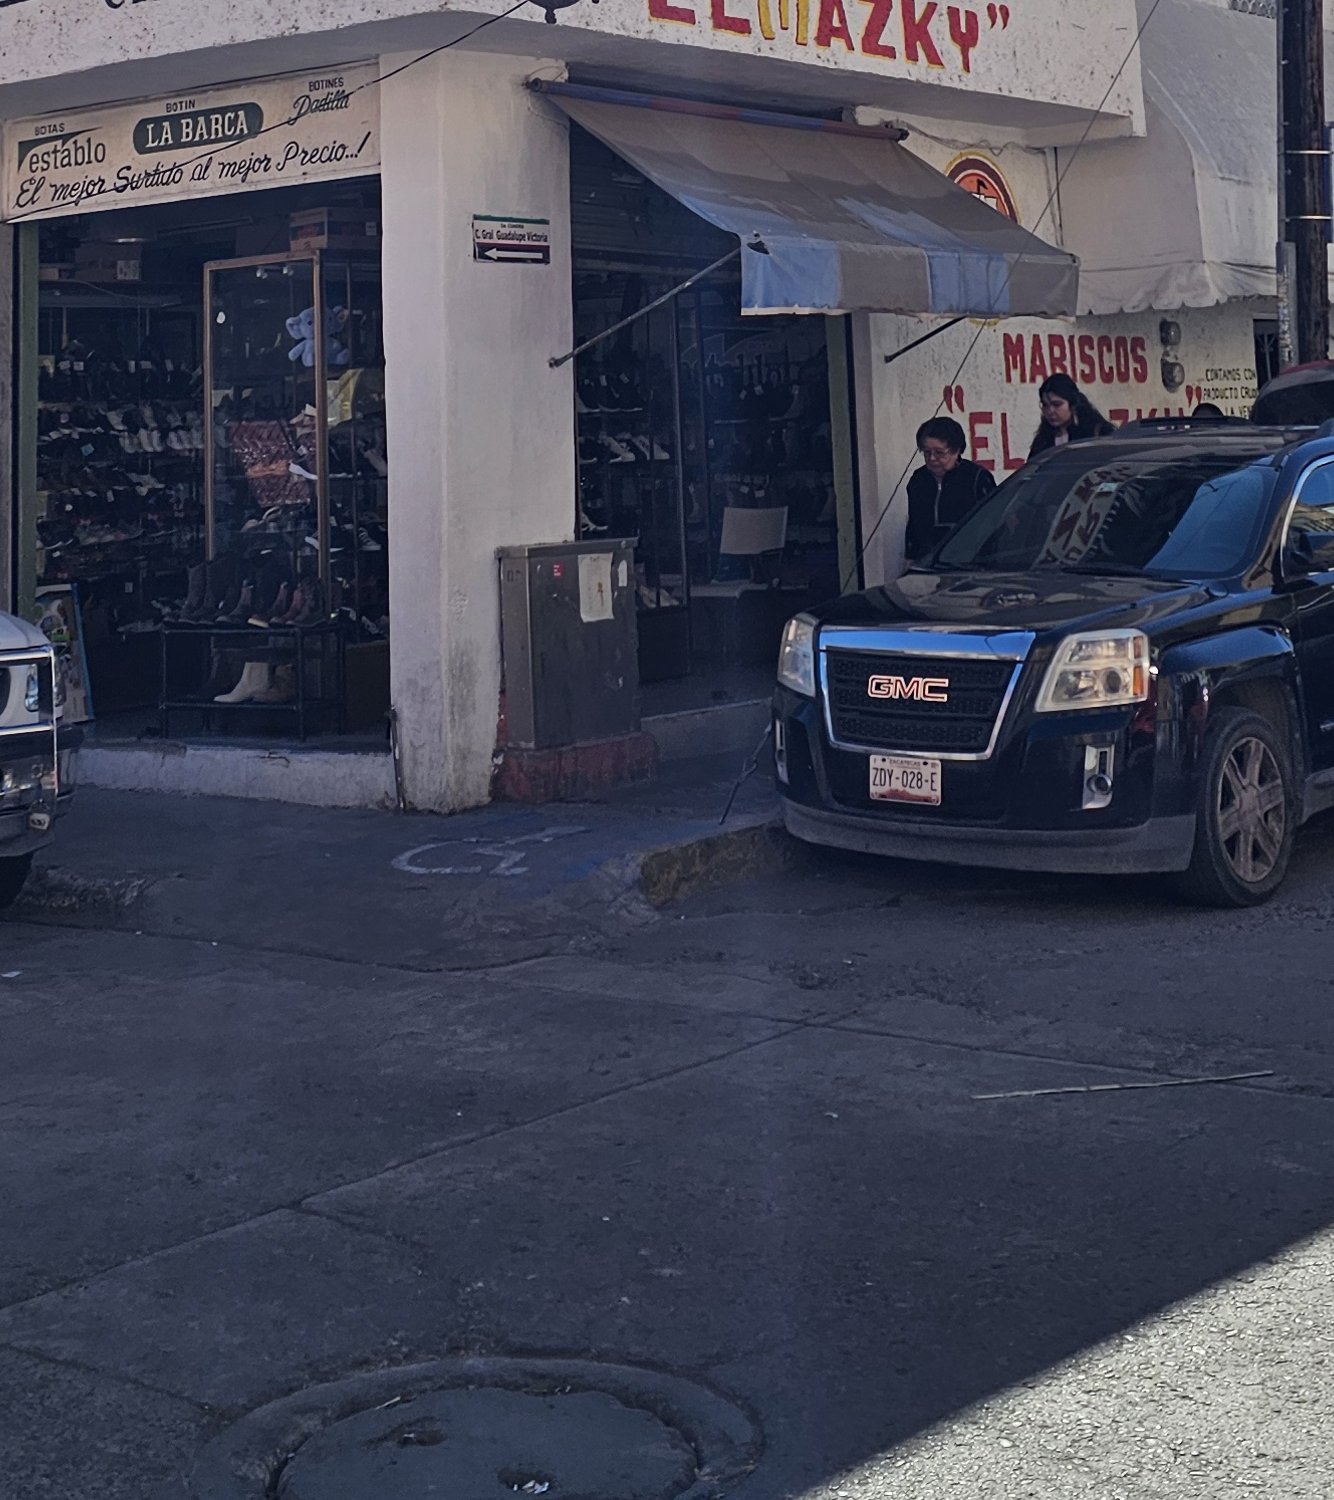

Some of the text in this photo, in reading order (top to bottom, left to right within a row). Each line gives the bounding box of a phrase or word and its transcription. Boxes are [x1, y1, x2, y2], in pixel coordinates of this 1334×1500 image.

[309, 77, 344, 92] BOTINES
[166, 99, 196, 113] BOTIN
[34, 123, 65, 137] BOTAS
[144, 111, 249, 148] LA BARCA
[29, 138, 106, 173] establo
[15, 175, 41, 209] El
[50, 174, 107, 208] mejor
[116, 161, 184, 194] Surtido
[219, 152, 273, 184] mejor
[496, 230, 526, 243] Guadalupe
[526, 231, 548, 243] Victoria
[1003, 333, 1148, 384] MARISCOS
[1205, 368, 1241, 382] CONTAMOS
[1203, 387, 1238, 400] PRODUCTO
[868, 675, 949, 702] GMC
[872, 767, 938, 792] ZDY-028-E
